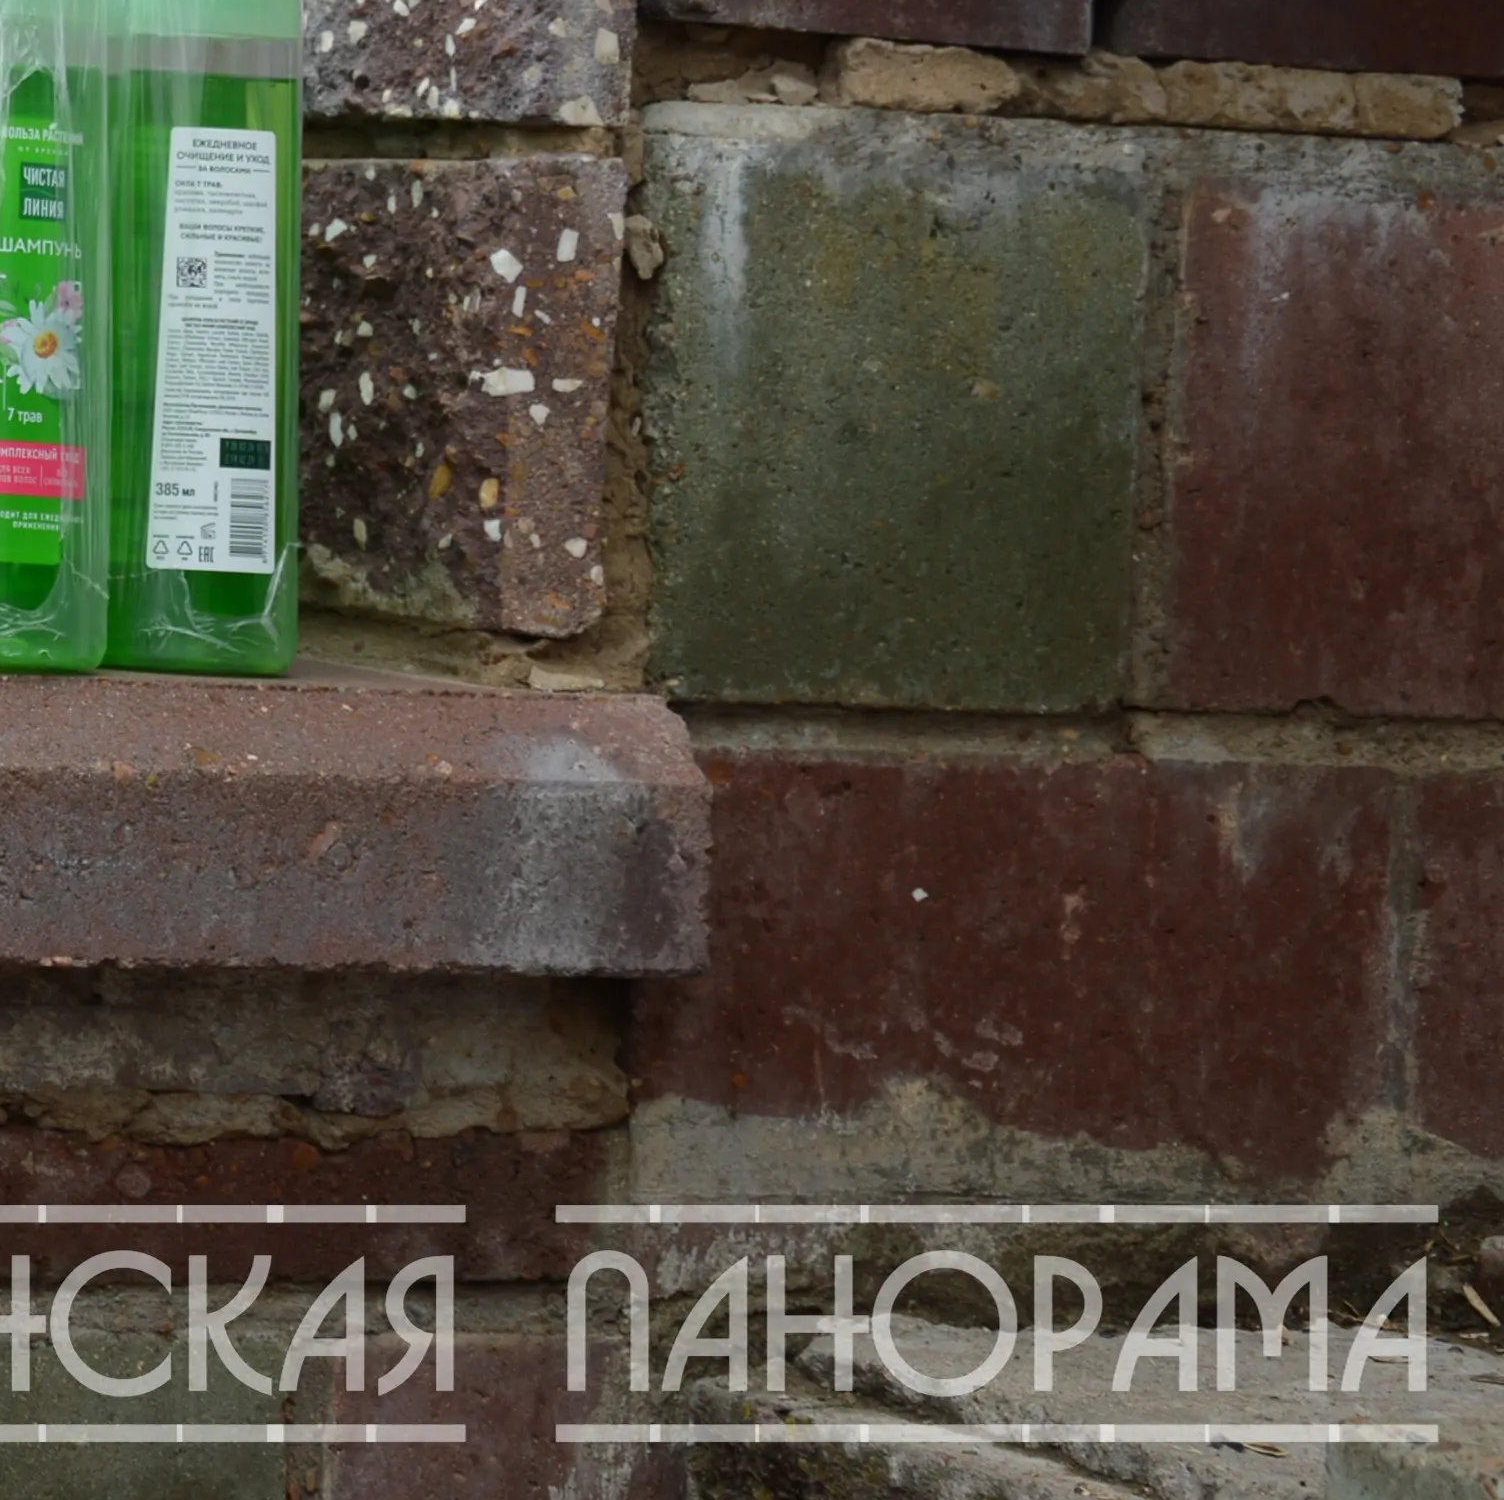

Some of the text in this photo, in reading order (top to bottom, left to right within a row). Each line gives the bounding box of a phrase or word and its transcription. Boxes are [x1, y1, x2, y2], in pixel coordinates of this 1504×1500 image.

[192, 138, 257, 151] ЕЖЕДНЕВНОЕ
[176, 151, 271, 165] ОЧИЩЕНИЕ И УХОД
[23, 167, 65, 187] ЧИСТАЯ
[23, 198, 64, 219] ЛИНИЯ
[7, 407, 43, 425] 7 трав
[155, 482, 196, 497] 385 мл
